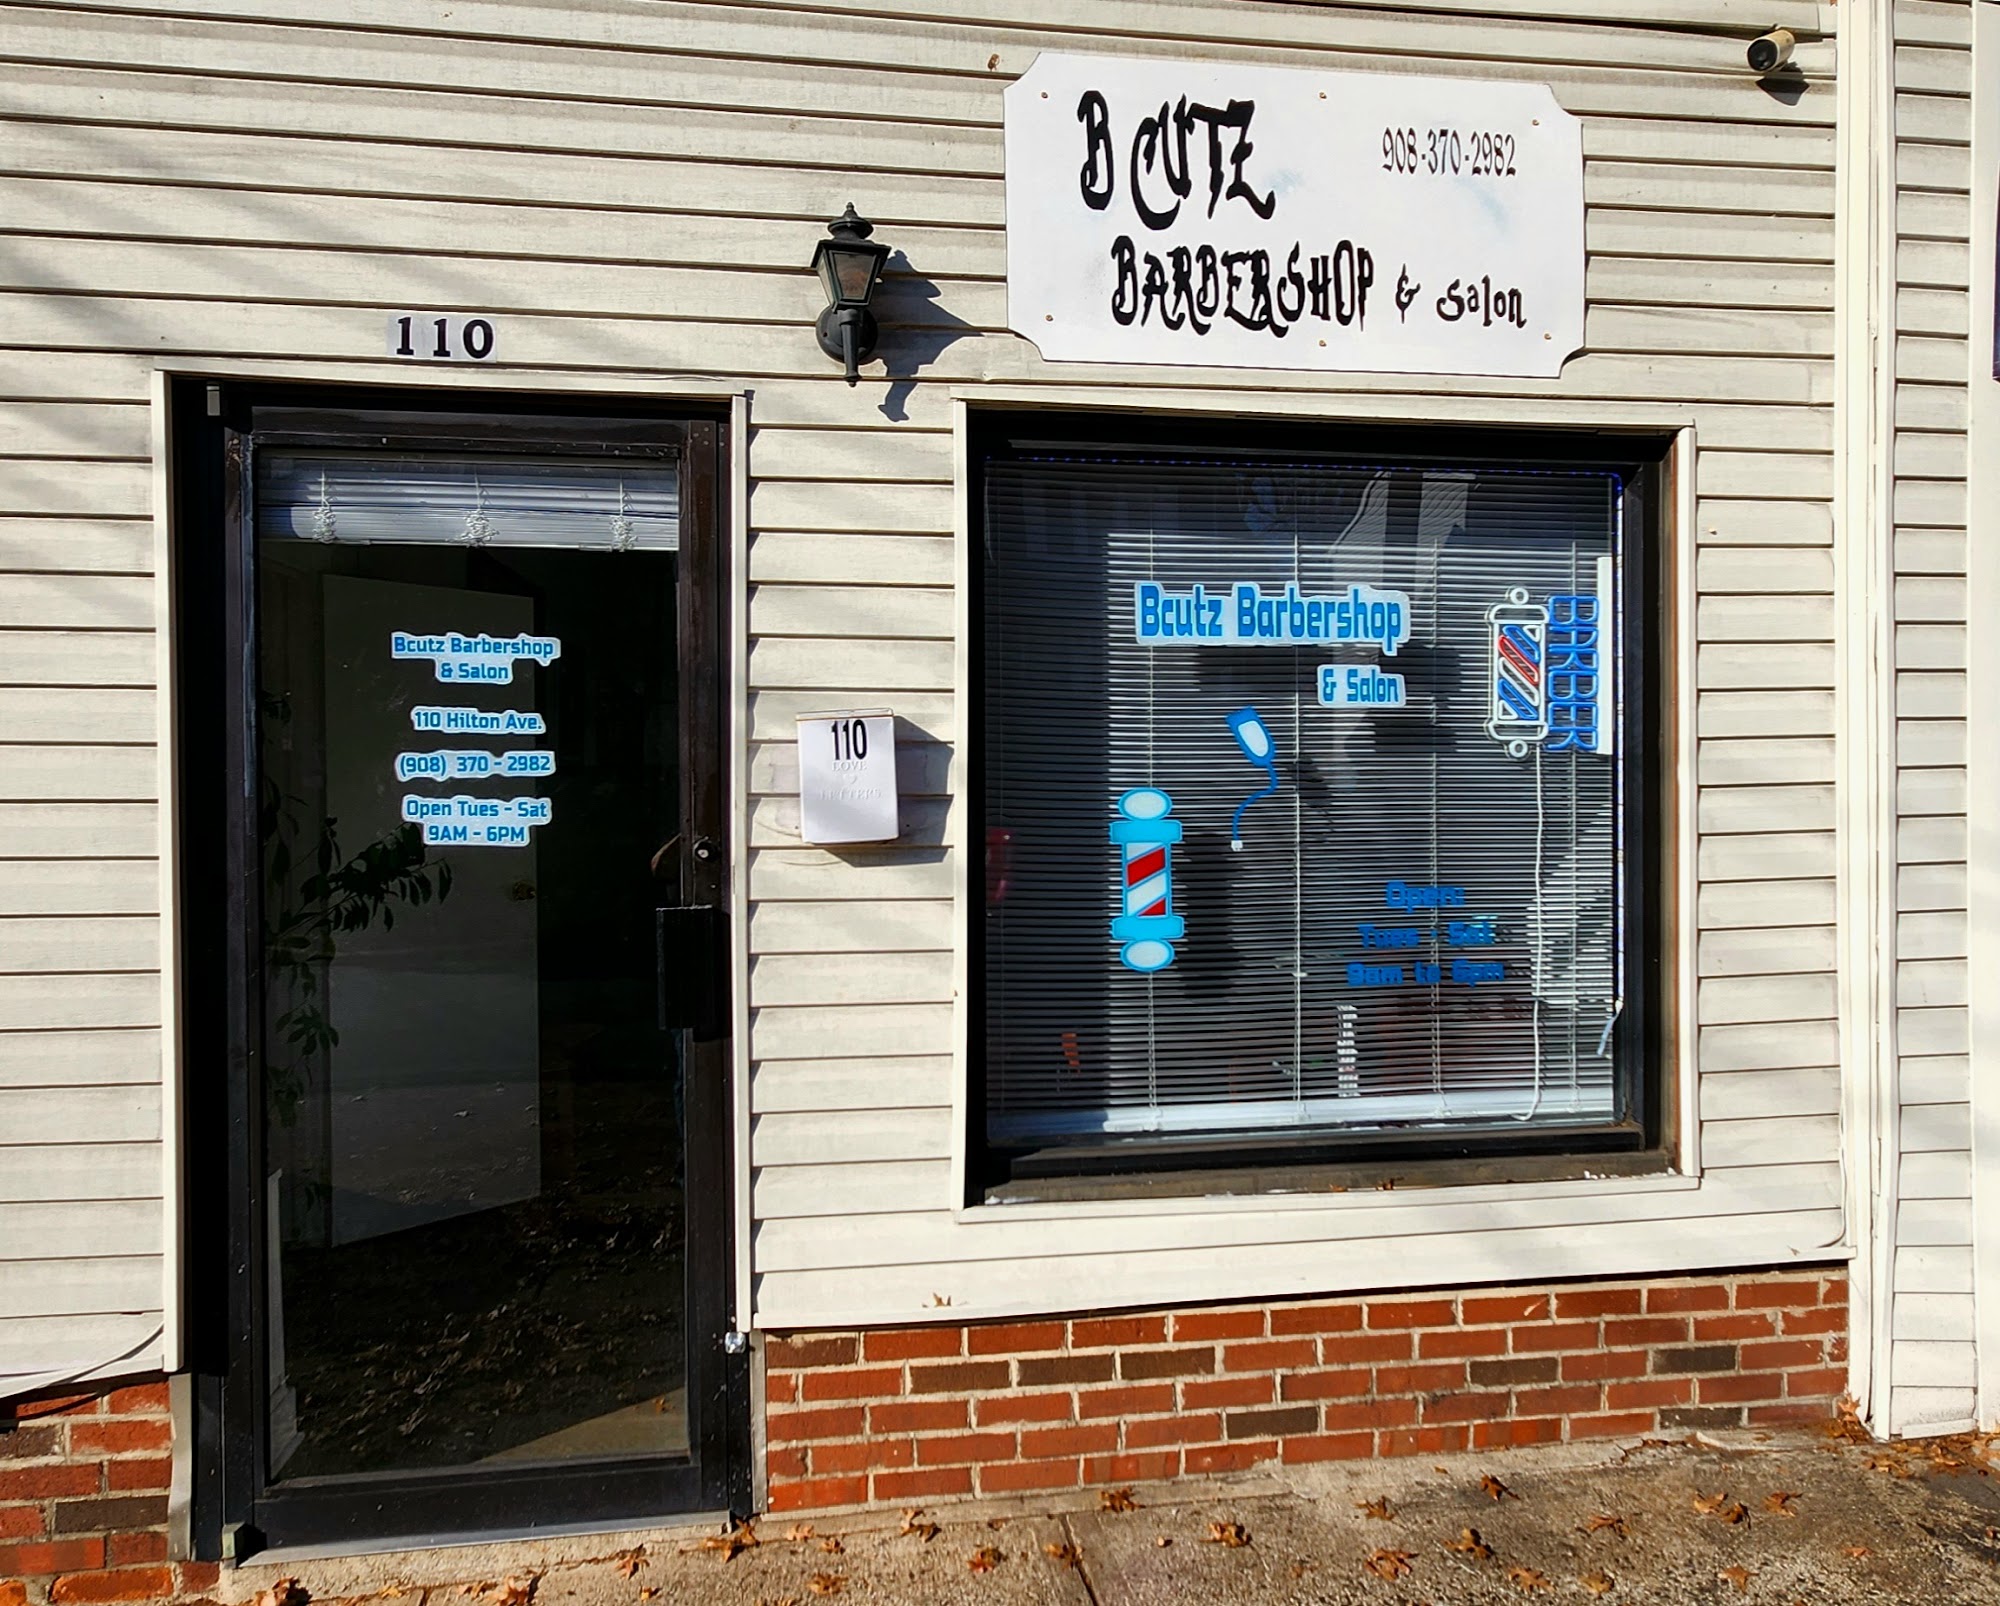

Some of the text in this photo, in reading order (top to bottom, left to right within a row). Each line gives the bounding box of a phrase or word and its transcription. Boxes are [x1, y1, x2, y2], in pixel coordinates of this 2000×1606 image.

[1076, 90, 1276, 230] B CUTZ
[1382, 127, 1517, 177] 908-370-2982
[1110, 235, 1527, 338] BARBERSHOP & Salon
[396, 316, 494, 359] 110
[1140, 584, 1401, 652] Bcutz Barbershop
[394, 636, 554, 658] Bcutz Barbershop
[441, 662, 509, 679] & Salon
[1322, 668, 1399, 703] & Salon
[1547, 595, 1600, 751] BARBER
[414, 711, 543, 730] 110 Hilton Ave.
[831, 719, 868, 760] 110
[399, 754, 447, 777] (908)
[456, 756, 489, 772] 370
[507, 755, 551, 771] 2982
[406, 799, 452, 818] Open
[457, 800, 499, 817] Tues
[517, 801, 548, 817] Sat
[428, 825, 467, 841] 9AM
[486, 826, 525, 842] 6PM
[1357, 923, 1421, 949] Tues
[1447, 921, 1497, 946] Sat
[1414, 961, 1442, 984] to
